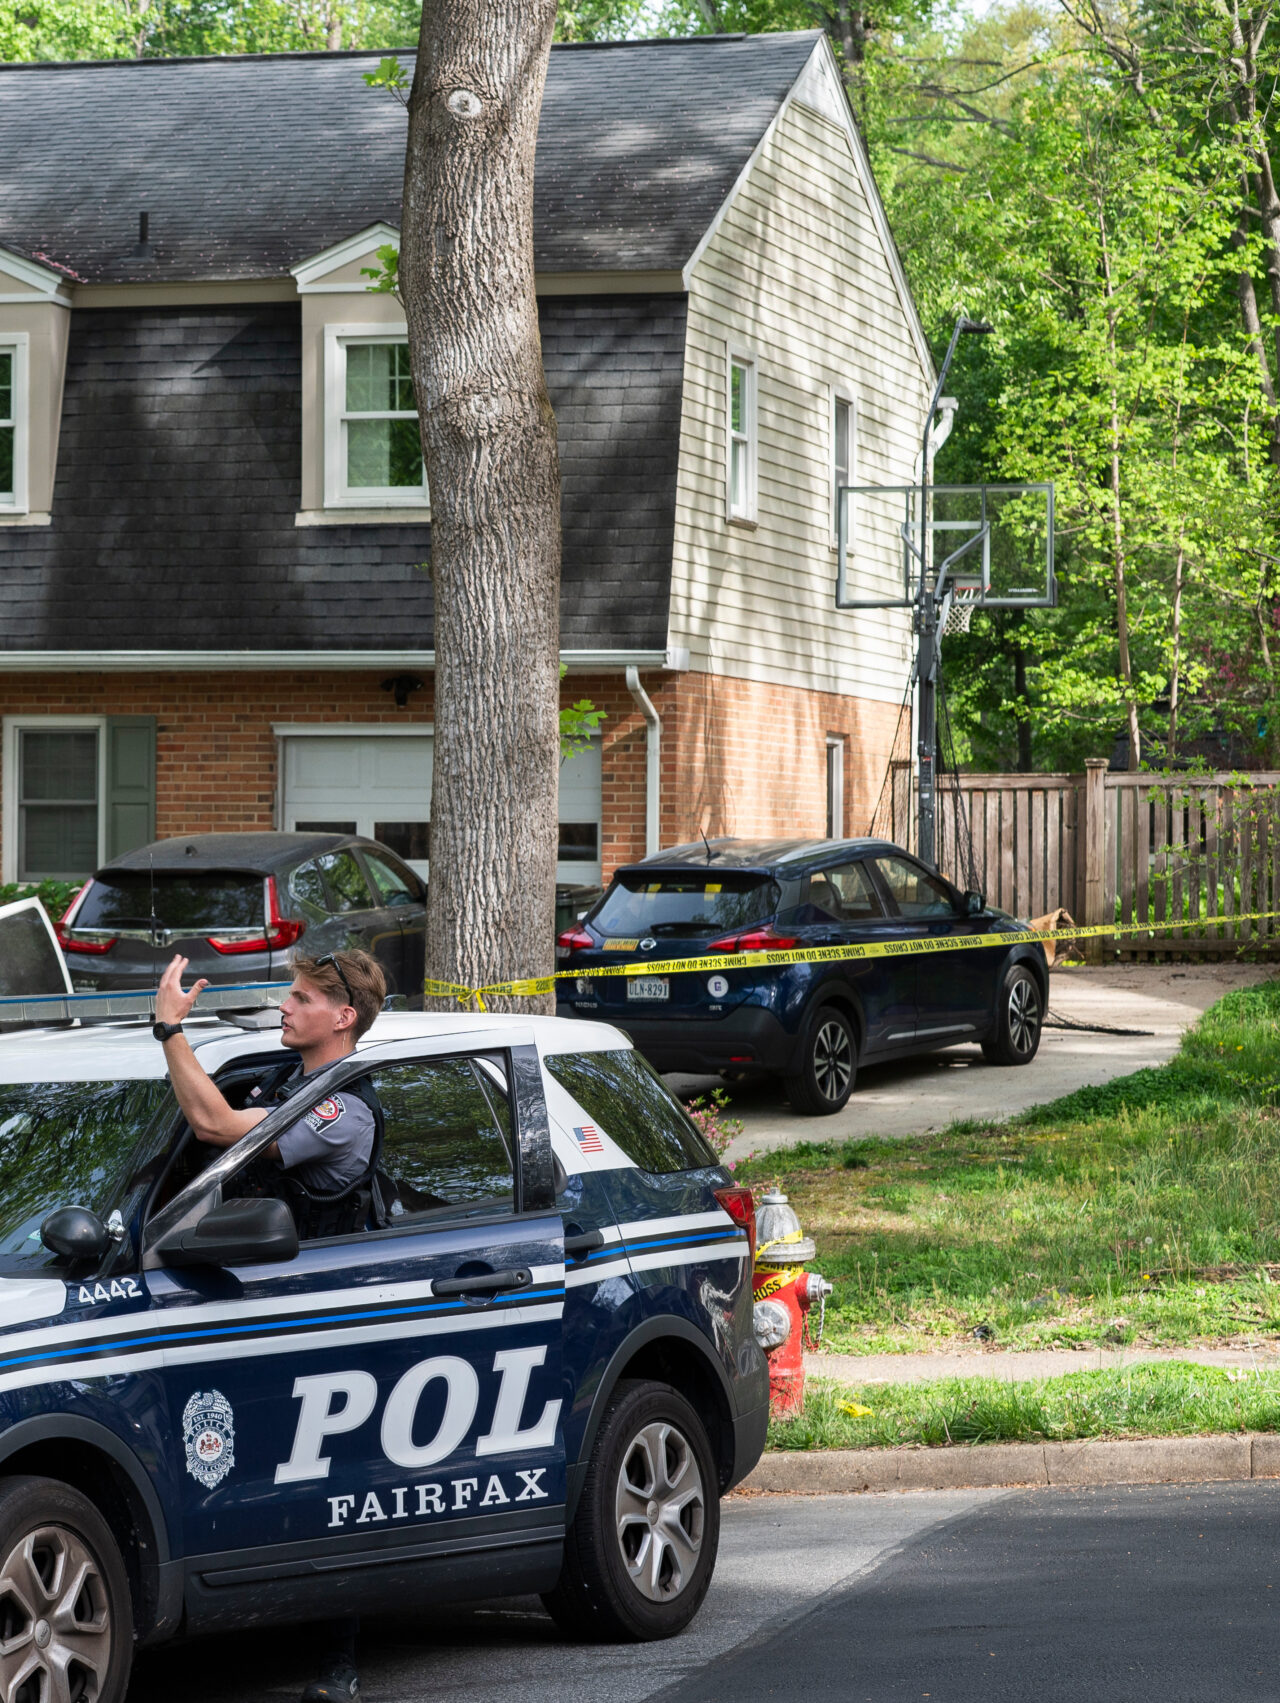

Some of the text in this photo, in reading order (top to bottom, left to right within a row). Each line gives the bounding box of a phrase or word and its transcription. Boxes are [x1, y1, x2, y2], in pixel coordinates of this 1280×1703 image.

[1000, 933, 1024, 942] CROSS
[1025, 932, 1040, 940] NOT
[884, 936, 983, 954] CRIME SCENE DO NOT CROSS
[766, 946, 866, 963] CRIME SCENE DO NOT CROSS
[647, 956, 747, 972] CRIME SCENE DO NOT CROSS
[629, 983, 667, 996] ULN-8291
[78, 1277, 143, 1305] 4442
[753, 1280, 781, 1303] ROSS
[273, 1344, 563, 1485] POL
[190, 1420, 227, 1437] POLICE
[327, 1467, 549, 1528] FAIRFAX
